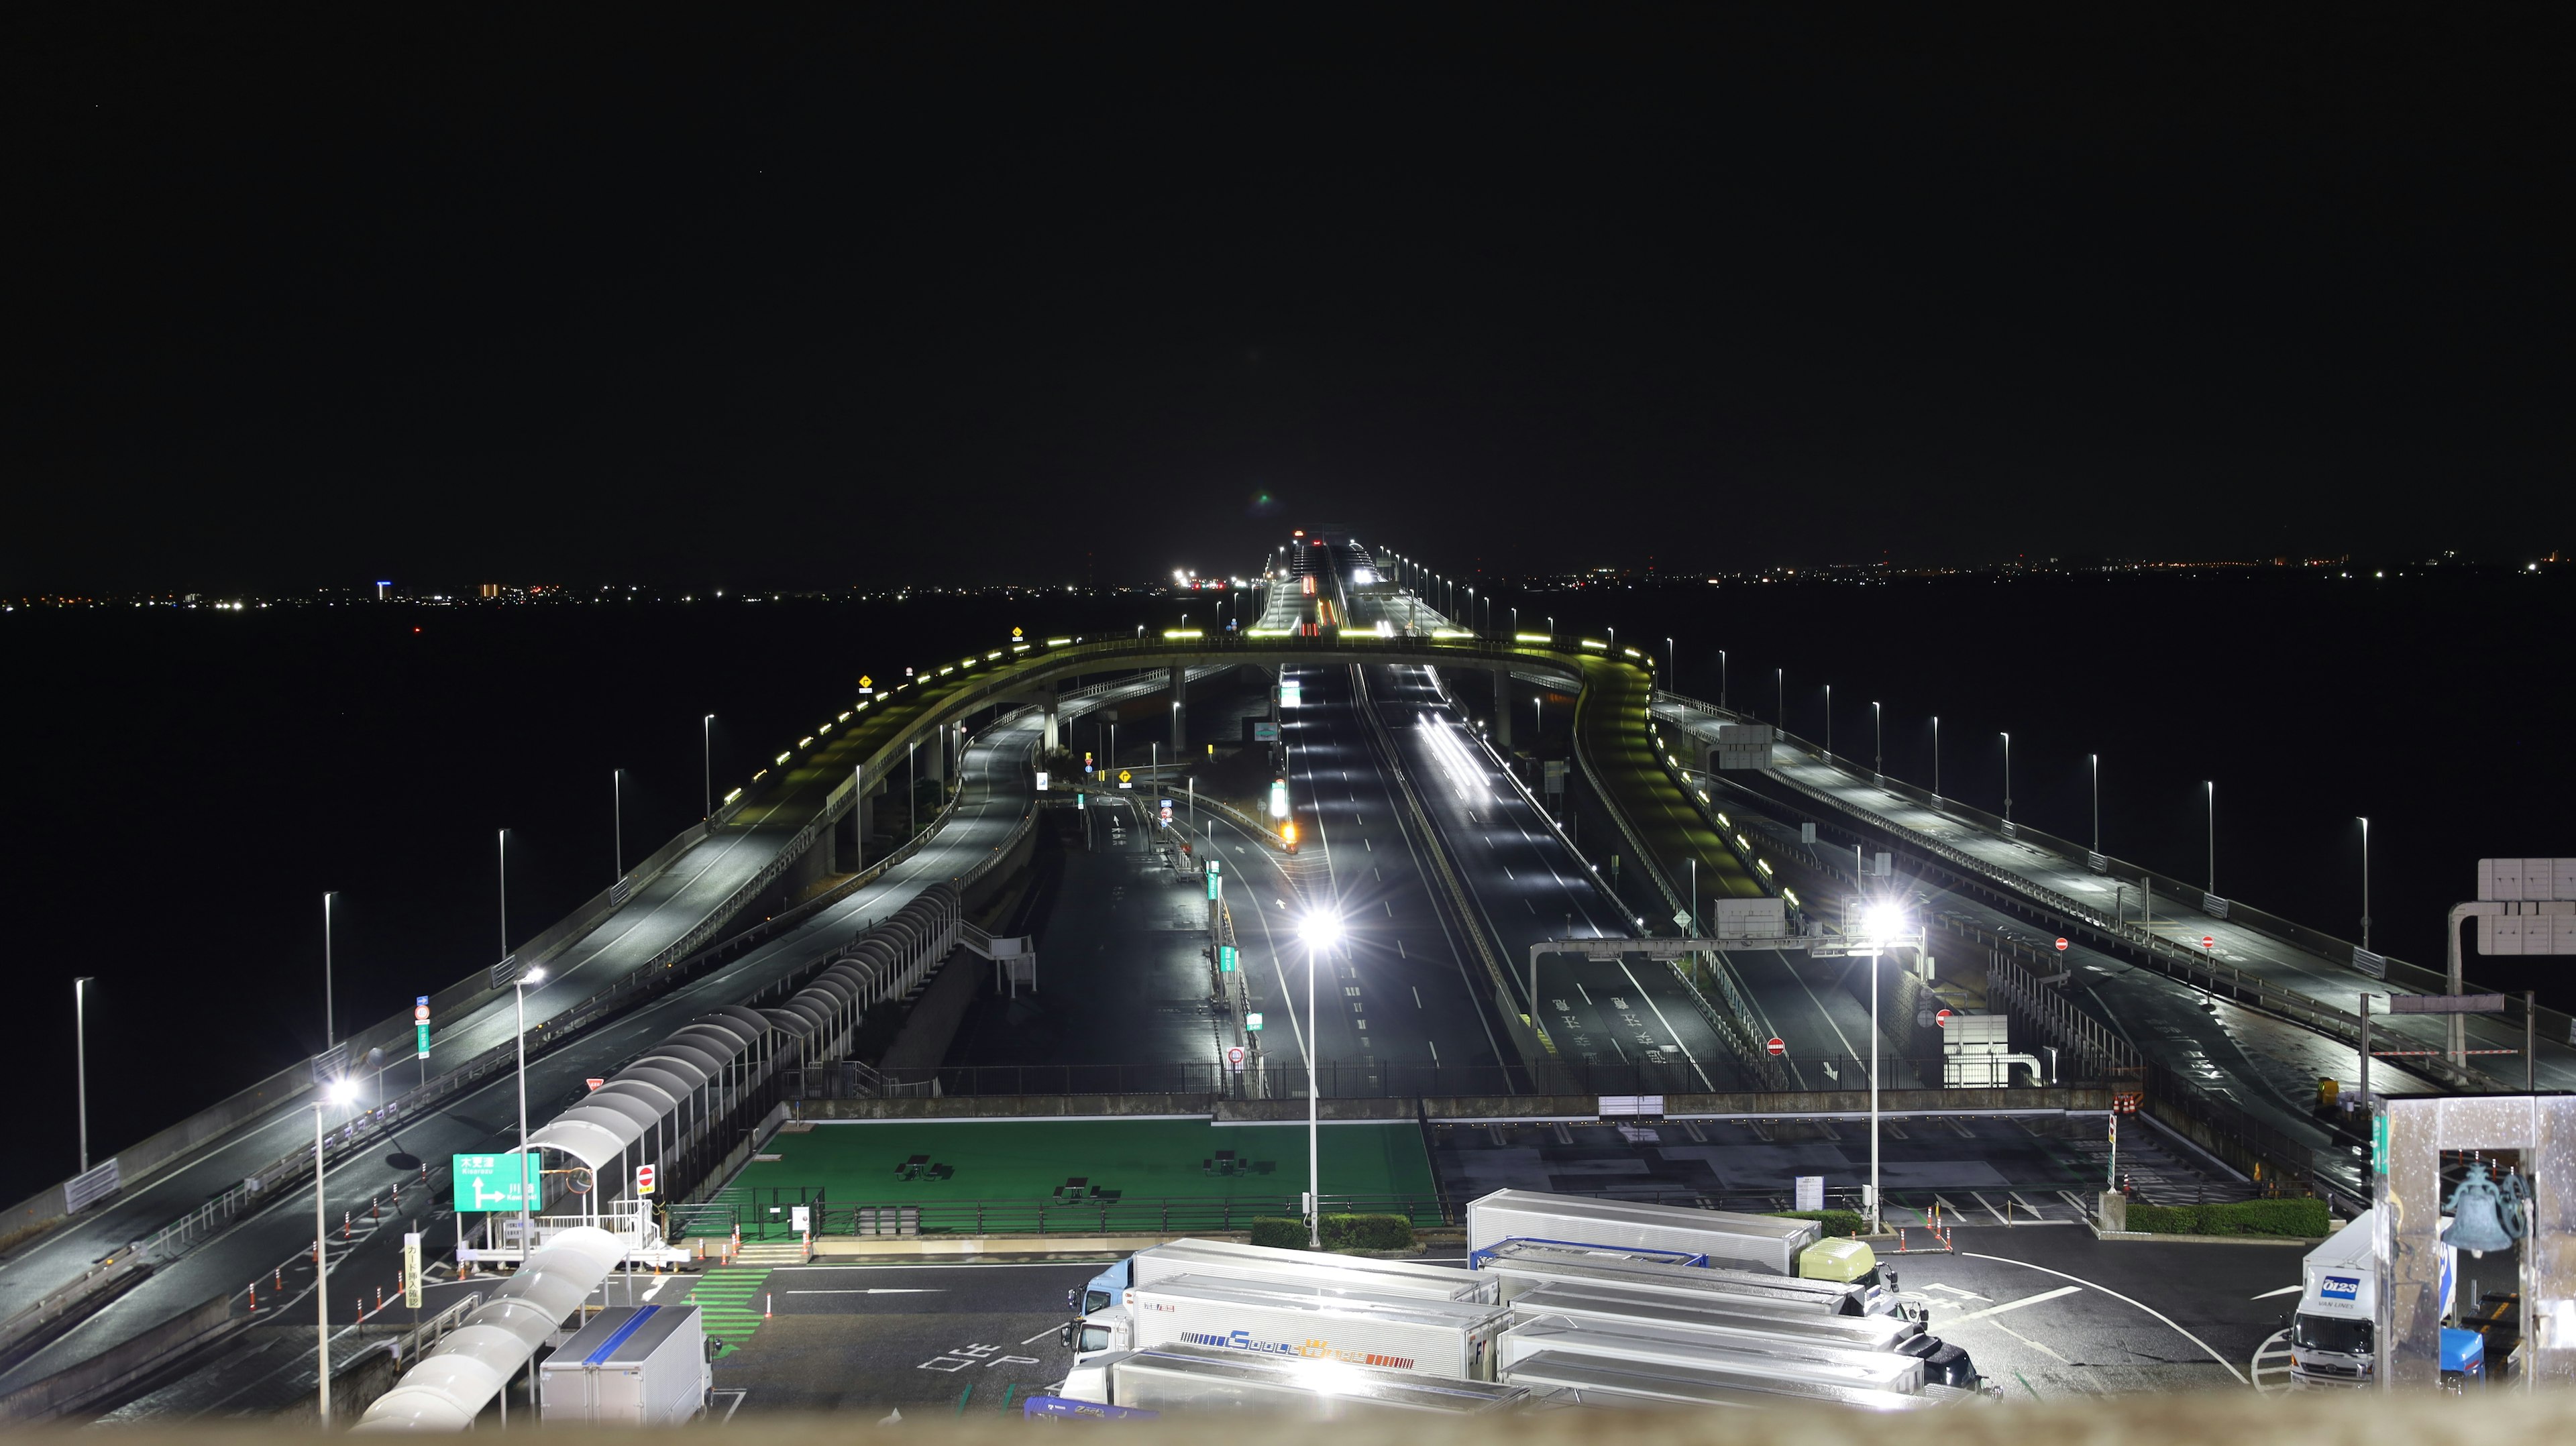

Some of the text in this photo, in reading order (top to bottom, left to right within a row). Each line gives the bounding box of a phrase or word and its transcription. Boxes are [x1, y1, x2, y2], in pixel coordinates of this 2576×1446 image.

[418, 1008, 427, 1017] 40
[461, 1156, 494, 1168] 木更津
[407, 1245, 419, 1307] カード挿入確認
[916, 1342, 1002, 1373] 出口
